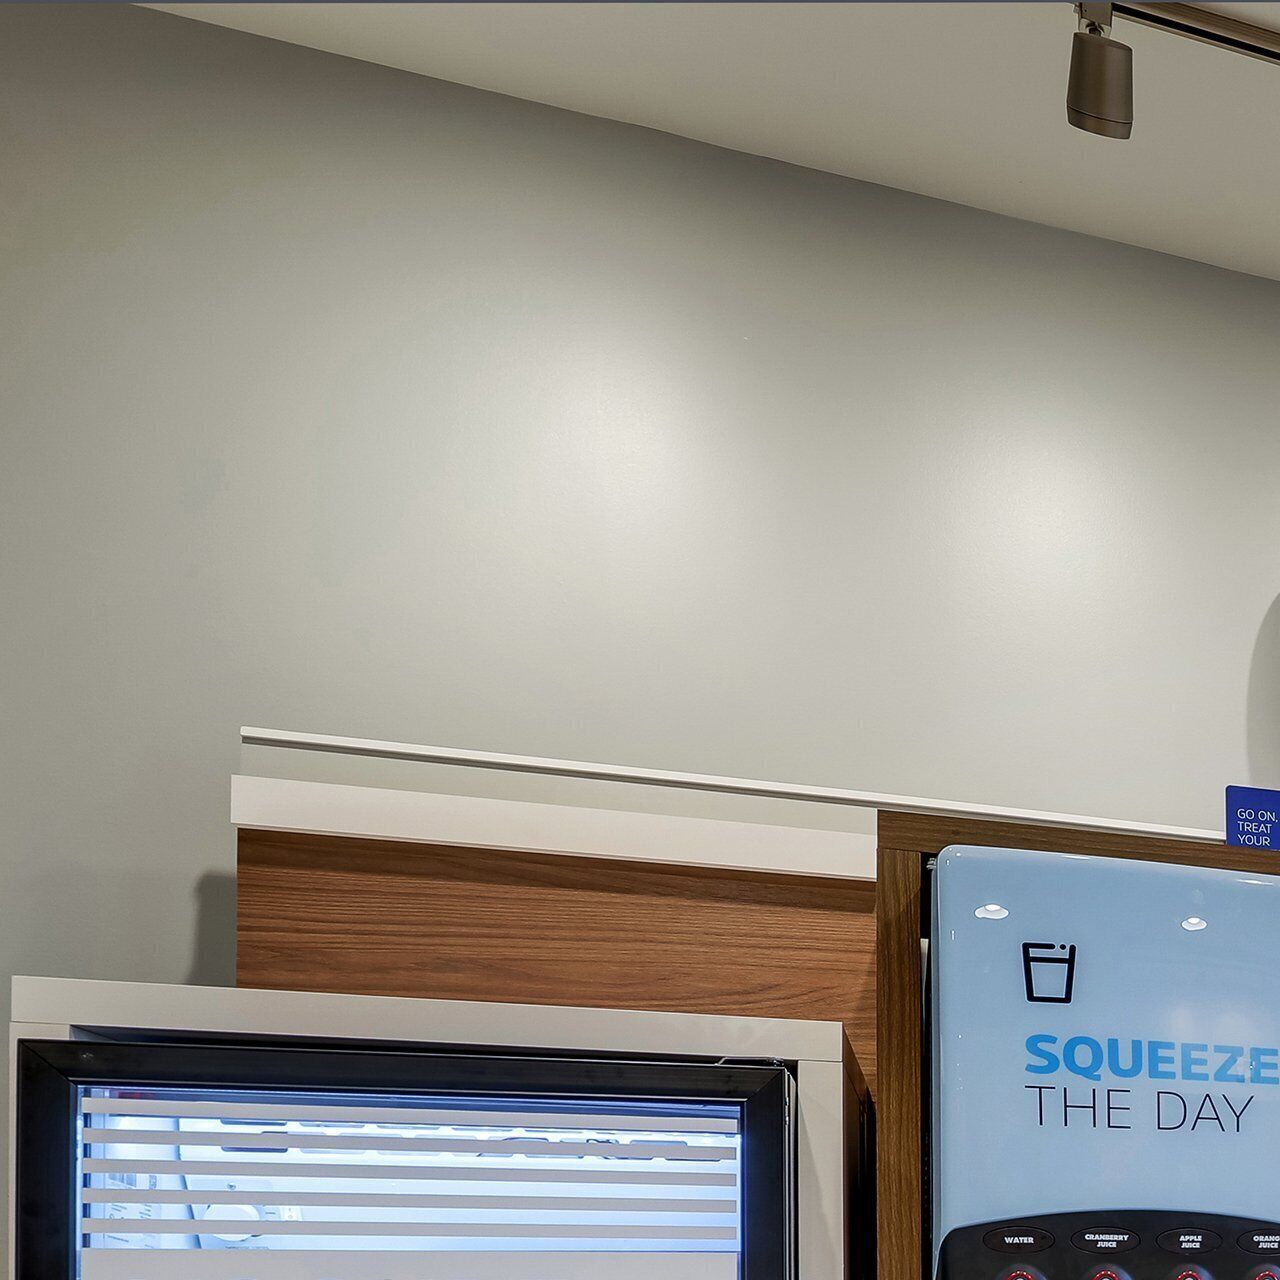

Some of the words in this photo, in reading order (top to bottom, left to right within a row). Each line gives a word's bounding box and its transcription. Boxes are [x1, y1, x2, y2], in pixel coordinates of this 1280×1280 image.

[1237, 808, 1255, 820] GO
[1258, 810, 1279, 823] ON,
[1237, 821, 1272, 834] TREAT
[1238, 834, 1271, 847] YOUR
[1024, 1033, 1280, 1085] SQUEEZE
[1024, 1084, 1132, 1131] THE
[1155, 1091, 1255, 1133] DAY
[1004, 1236, 1034, 1244] WATER
[1084, 1234, 1129, 1242] CRANBERRY
